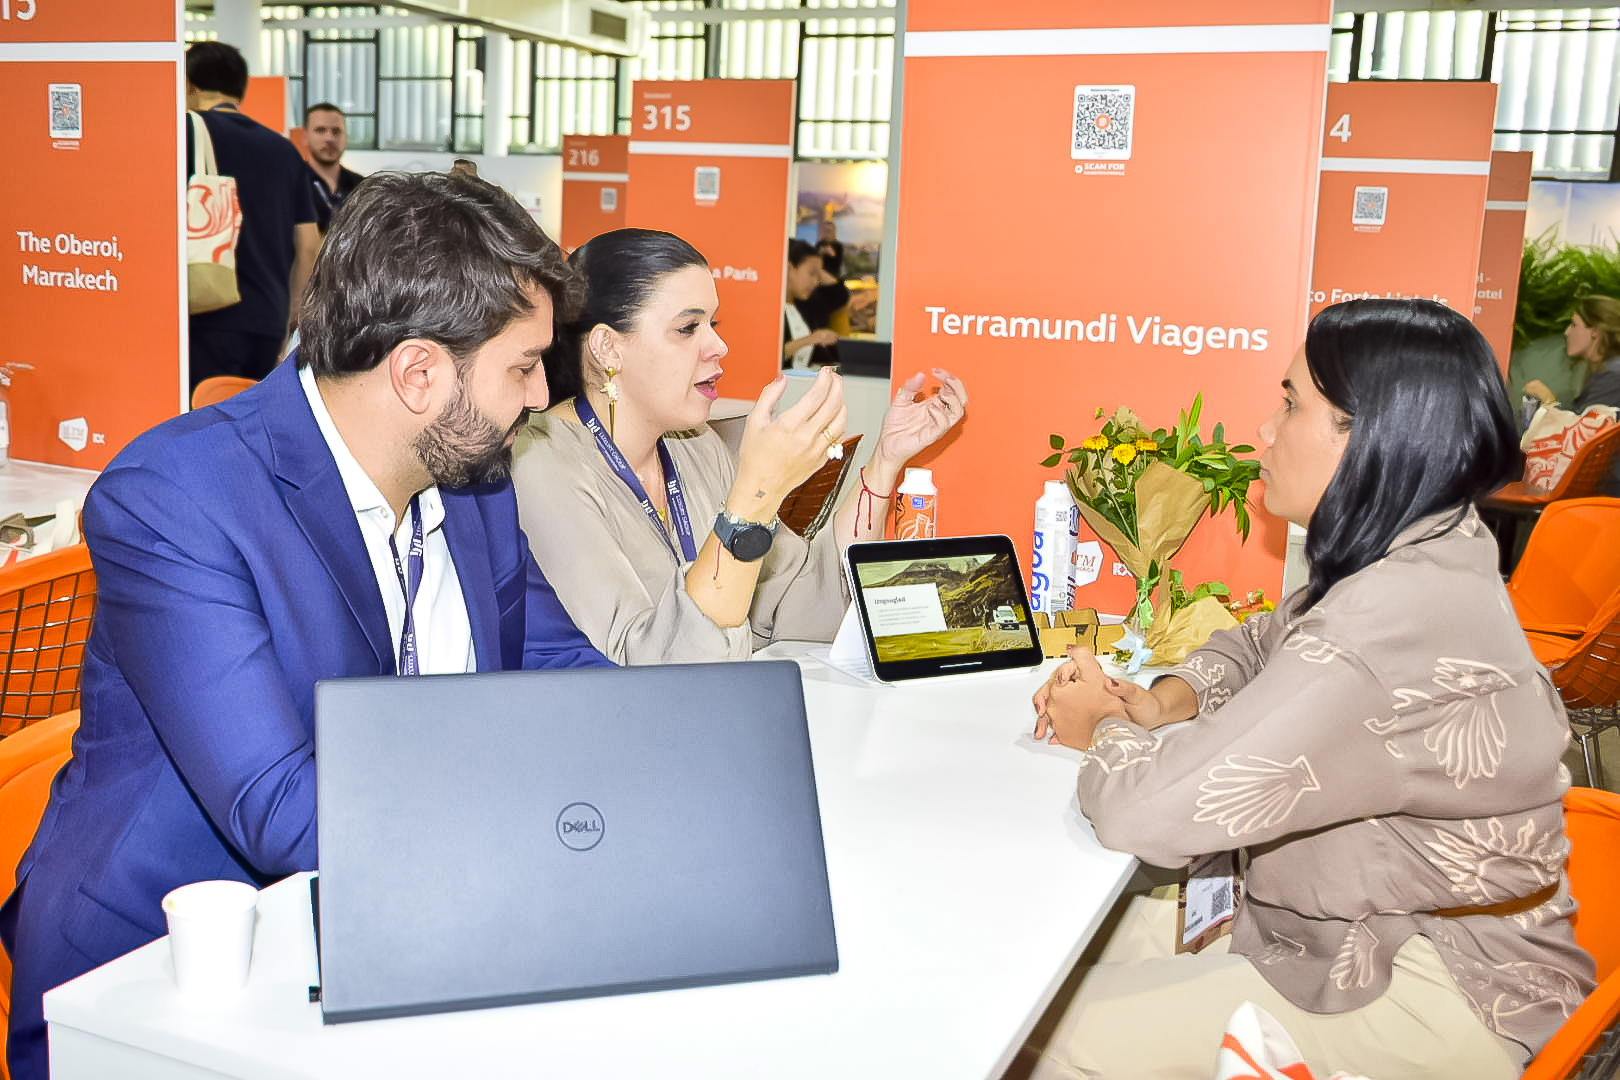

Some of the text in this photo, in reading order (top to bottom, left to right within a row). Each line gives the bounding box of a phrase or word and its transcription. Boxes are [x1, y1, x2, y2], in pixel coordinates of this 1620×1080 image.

[642, 105, 692, 131] 315
[1329, 113, 1352, 143] 4
[568, 149, 600, 166] 216
[16, 230, 124, 262] The Oberoi,
[22, 263, 119, 291] Marrakech
[723, 264, 759, 282] Paris
[1477, 288, 1503, 300] otel
[924, 305, 1269, 355] Terramundi Viagens
[562, 819, 601, 834] DELL
